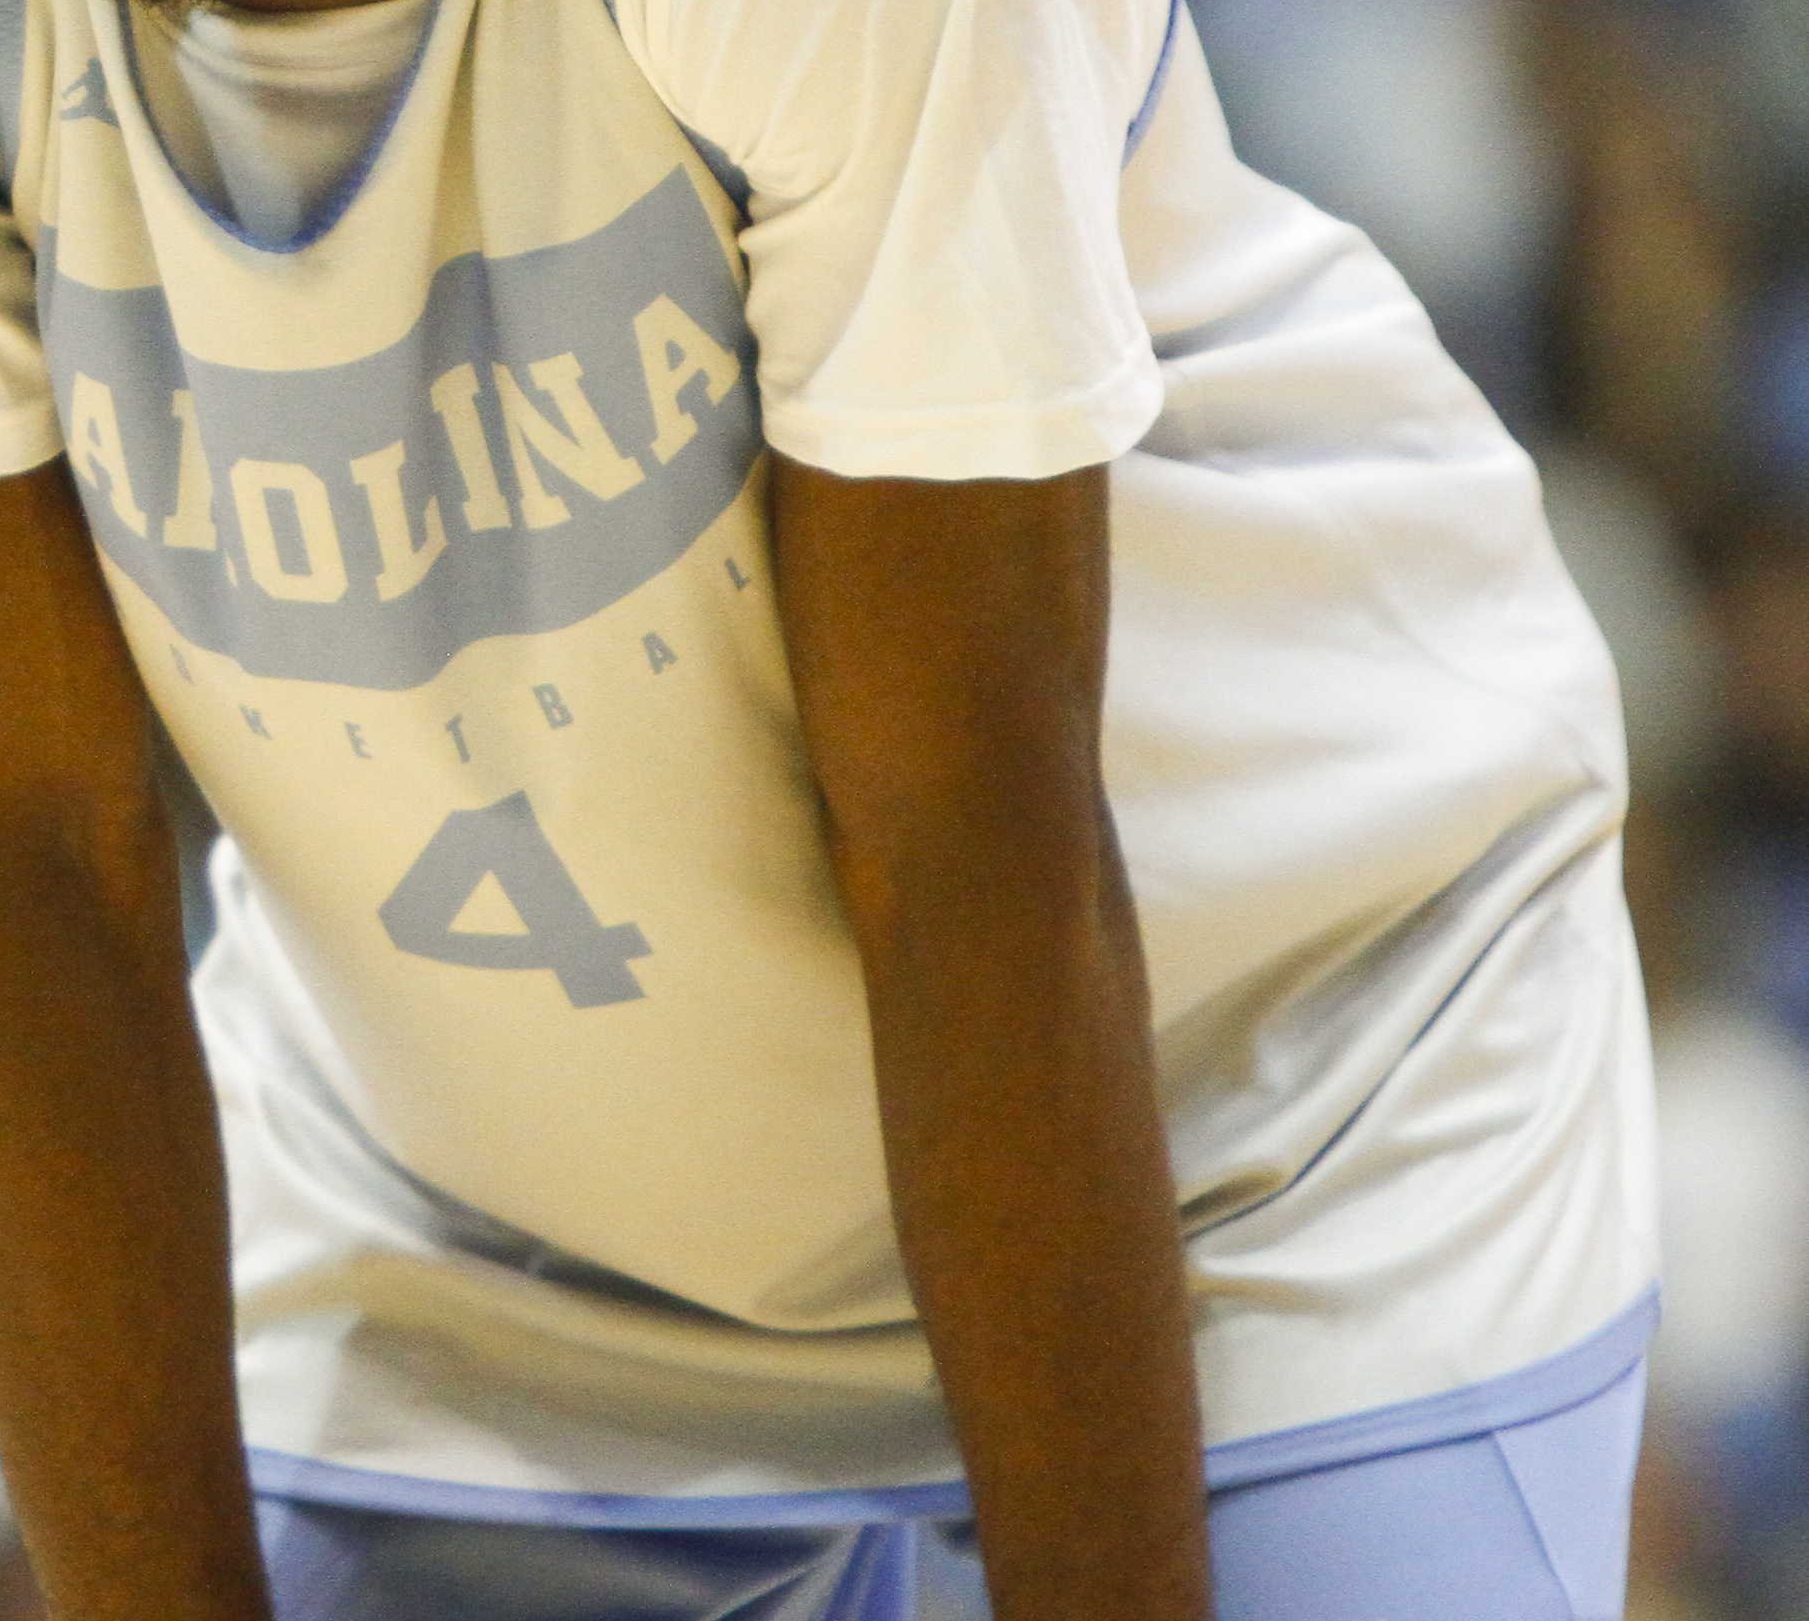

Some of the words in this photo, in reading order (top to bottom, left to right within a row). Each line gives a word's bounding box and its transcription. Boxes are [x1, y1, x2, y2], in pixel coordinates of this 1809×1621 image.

[67, 294, 742, 604] AOLINA
[169, 558, 752, 764] KETBAL
[377, 789, 654, 1010] 4
